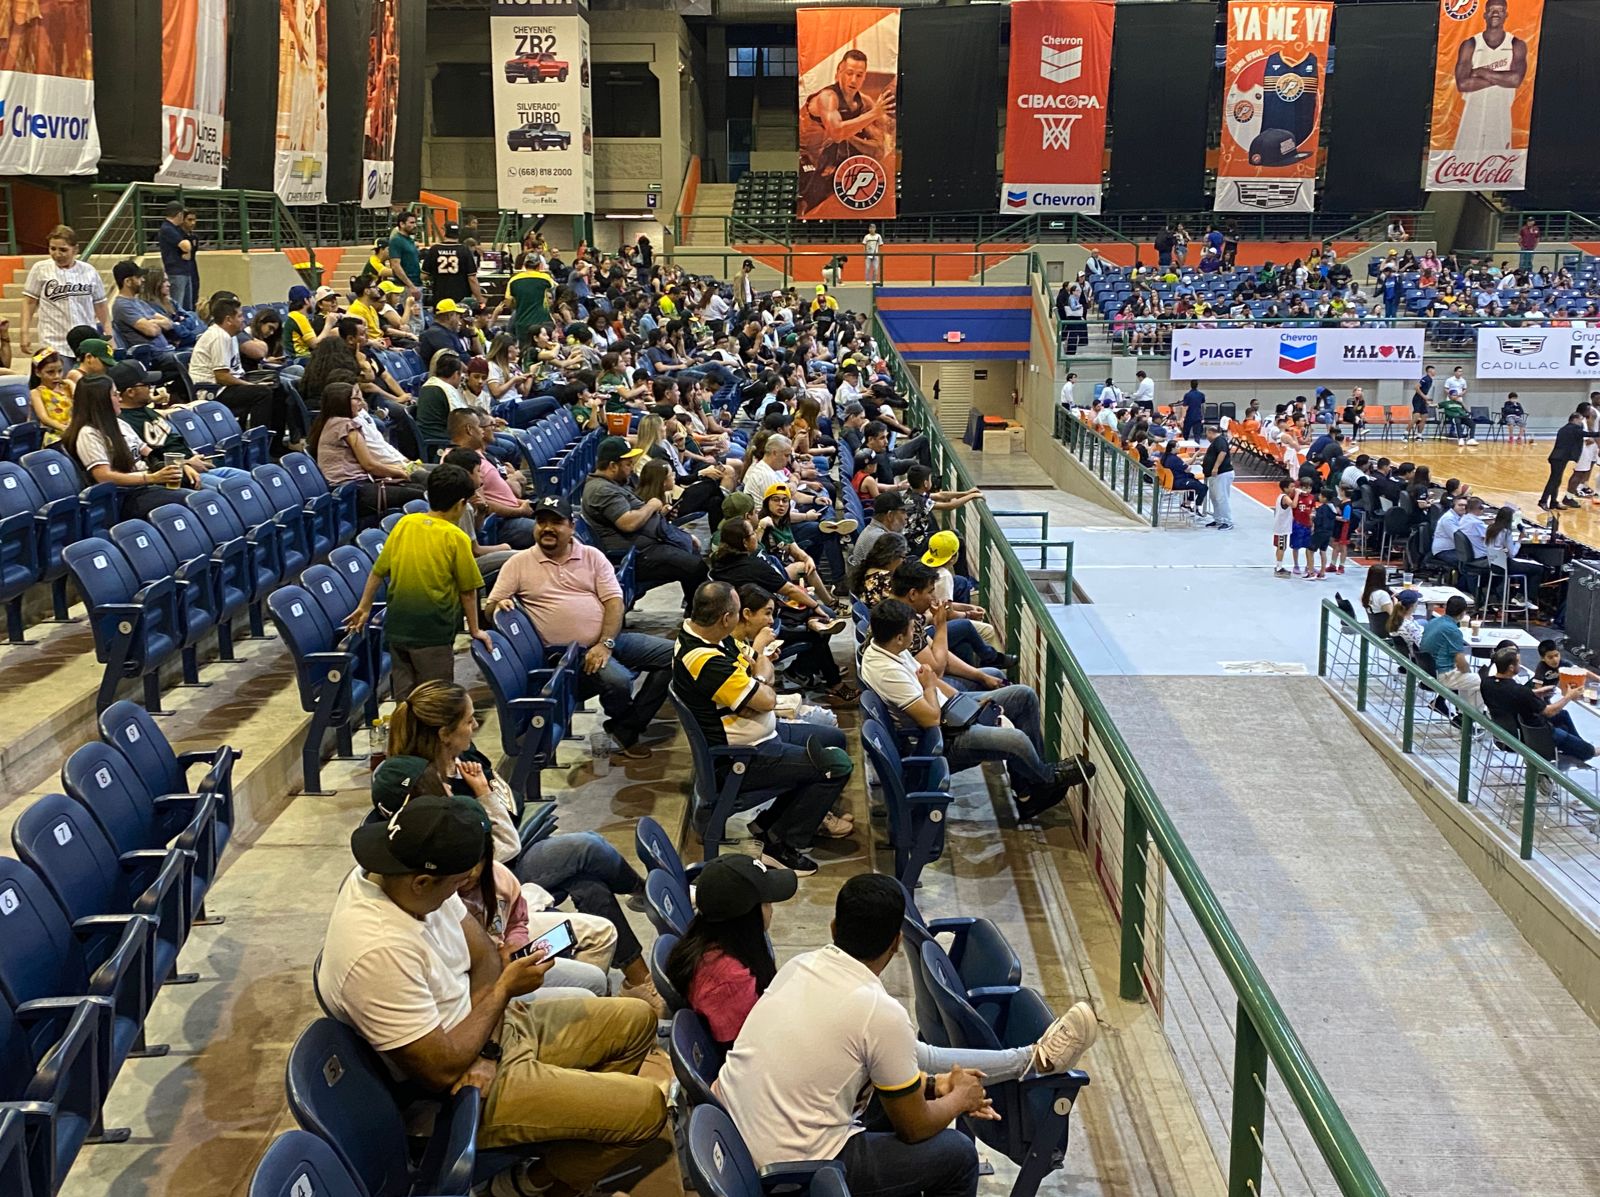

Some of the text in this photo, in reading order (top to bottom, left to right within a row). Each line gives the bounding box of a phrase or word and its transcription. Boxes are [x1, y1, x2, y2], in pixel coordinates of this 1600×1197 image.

[513, 26, 553, 34] CHEYENNE
[1233, 7, 1328, 42] YA ME VI
[515, 34, 557, 56] ZR2
[1042, 34, 1084, 45] Chevron
[517, 103, 557, 111] SILVERADO
[1017, 94, 1100, 109] CIBACOPA
[12, 105, 89, 140] Chevron
[518, 112, 560, 124] TURBO
[553, 168, 573, 177] 2000
[1435, 155, 1518, 184] Coca-Cola
[1033, 193, 1095, 206] Chevron
[437, 256, 459, 274] 23
[1280, 333, 1318, 342] Chevron
[1199, 348, 1253, 359] PIAGET
[1481, 361, 1560, 370] CADILLAC
